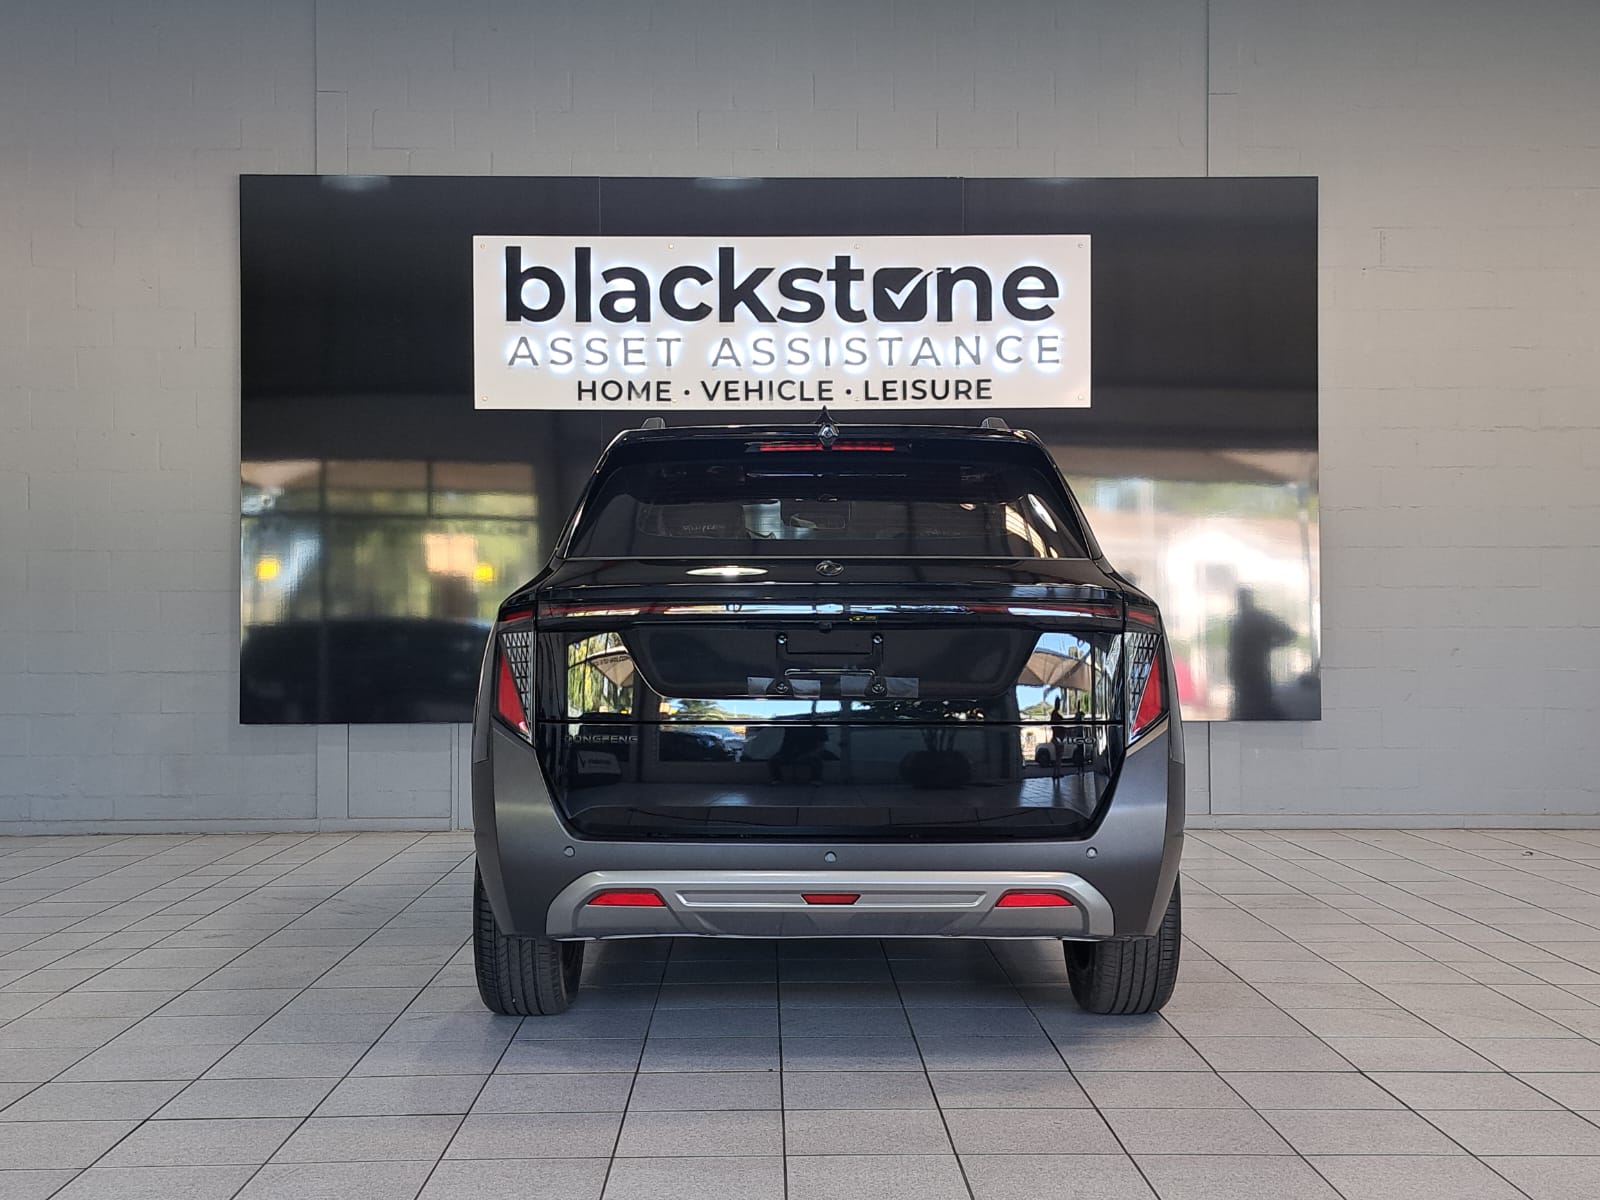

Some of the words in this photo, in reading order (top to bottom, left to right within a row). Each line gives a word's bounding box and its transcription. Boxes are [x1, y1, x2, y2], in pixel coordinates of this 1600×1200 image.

[508, 337, 681, 367] ASSET
[712, 335, 1061, 367] ASSISTANCE
[578, 381, 671, 401] HOME
[701, 381, 833, 401] VEHICLE
[865, 380, 992, 401] LEISURE
[564, 735, 638, 744] DONGFENG
